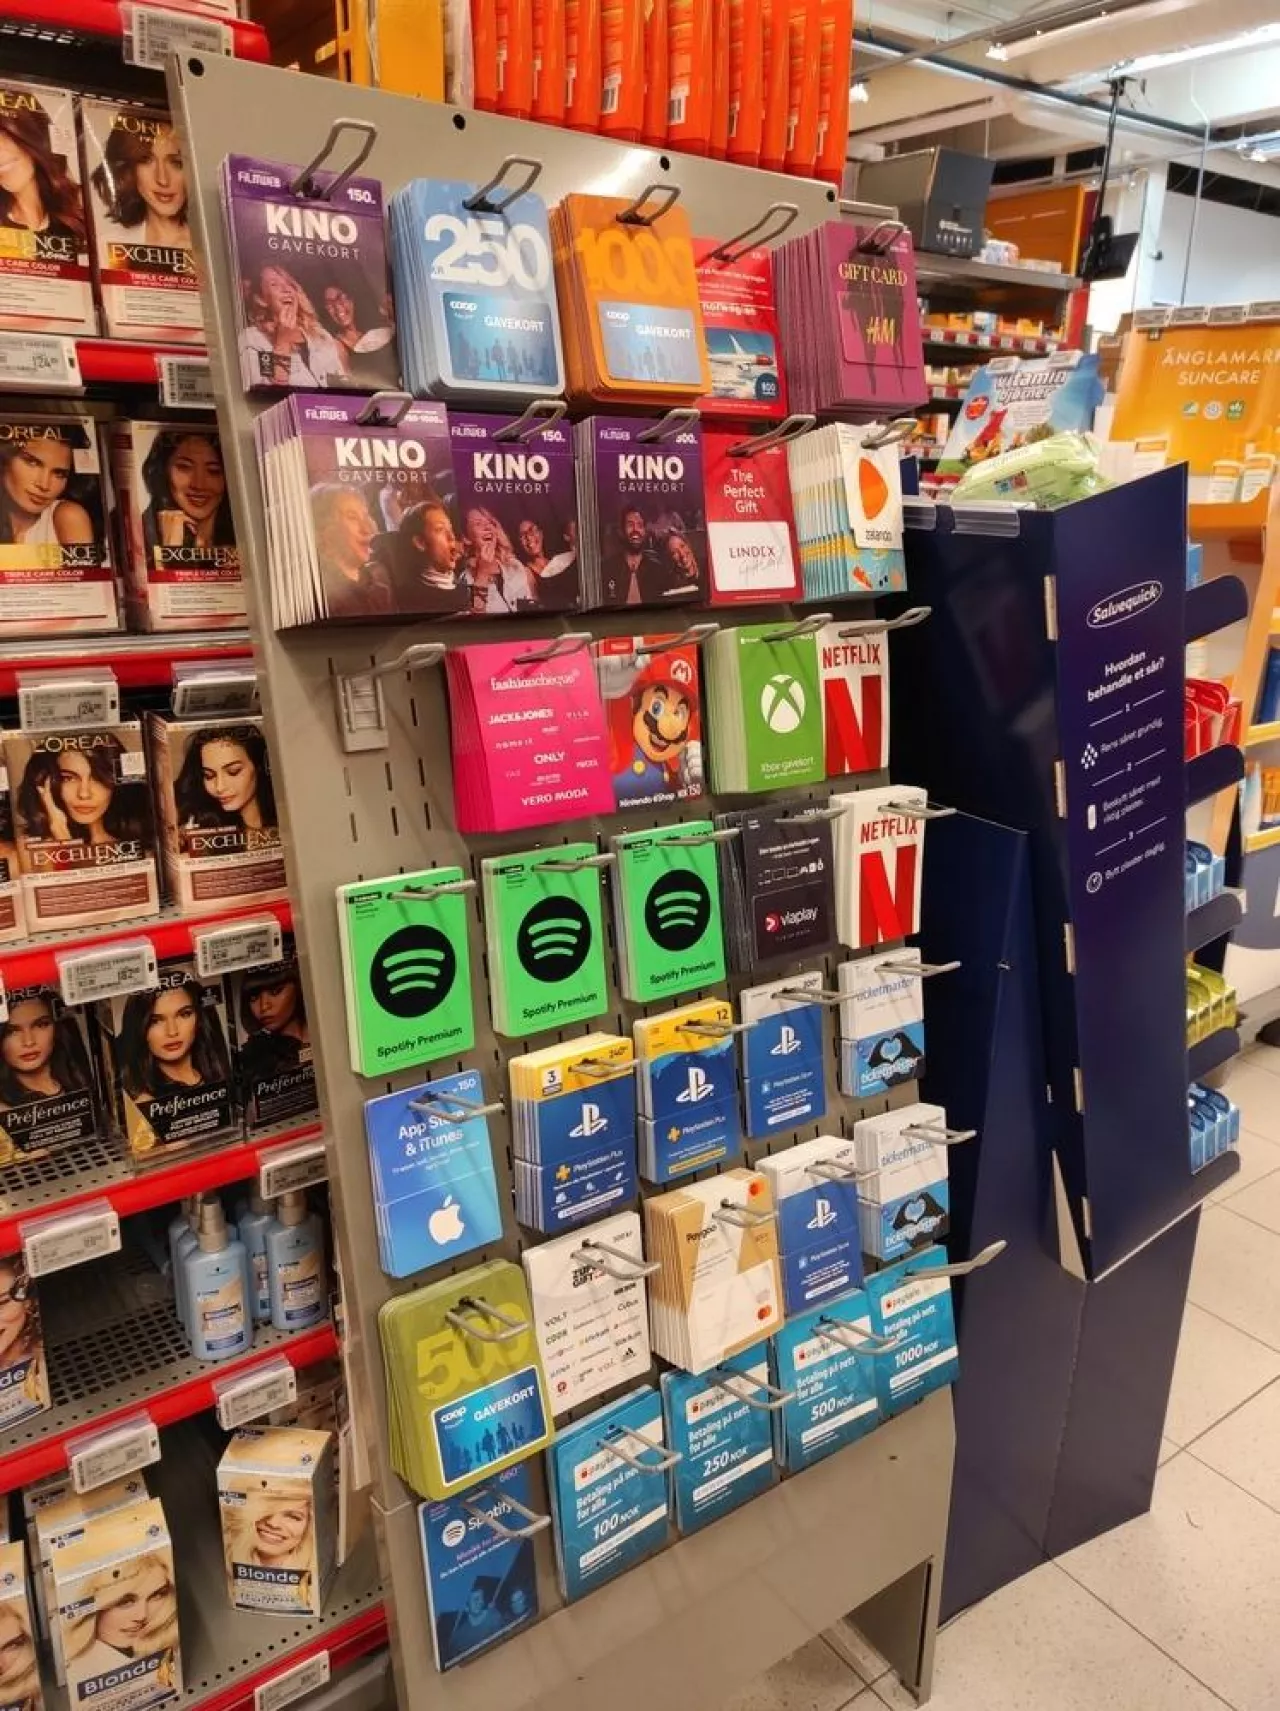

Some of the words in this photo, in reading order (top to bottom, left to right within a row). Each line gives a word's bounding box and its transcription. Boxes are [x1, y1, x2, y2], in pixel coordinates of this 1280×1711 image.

[265, 203, 358, 244] KINO
[267, 238, 361, 260] GAVEKORT
[424, 213, 550, 291] 250
[838, 261, 870, 282] GIFT
[871, 266, 908, 287] CARD
[484, 314, 544, 333] GAVEKORT
[635, 323, 692, 340] GAVEKORT
[865, 316, 896, 346] H&M
[1177, 369, 1261, 386] SUNCARE
[334, 437, 426, 468] KINO
[338, 468, 429, 484] GAVEKORT
[473, 451, 551, 482] KINO
[618, 453, 685, 482] KINO
[730, 468, 755, 485] The
[473, 480, 552, 495] GAVEKORT
[618, 481, 686, 494] GAVEKORT
[722, 483, 767, 500] Perfect
[734, 499, 760, 514] Gift
[728, 546, 777, 560] LINDEX
[1091, 583, 1159, 624] Salvequick
[822, 644, 881, 670] NETFLIX
[1104, 649, 1147, 677] Hvordan
[1086, 674, 1133, 702] behandle
[1133, 670, 1146, 683] et
[533, 751, 566, 765] ONLY
[521, 792, 554, 807] VERO
[554, 786, 589, 802] MODA
[859, 815, 918, 845] NETFLIX
[33, 840, 142, 866] EXCELLENCE
[780, 907, 818, 927] viaplay
[649, 969, 680, 987] Spotify
[680, 958, 717, 978] Premium
[522, 1000, 557, 1021] Spotify
[556, 991, 599, 1013] Premium
[716, 1008, 729, 1021] 12
[377, 1038, 415, 1060] Spotify
[415, 1025, 463, 1051] Premium
[546, 1069, 558, 1084] 3
[149, 1087, 228, 1119] Préférence
[398, 1122, 427, 1140] App
[405, 1142, 417, 1157] &
[418, 1128, 465, 1152] iTunes
[894, 1343, 924, 1369] 1000
[473, 1385, 535, 1421] GAVEKORT
[810, 1396, 836, 1421] 500
[703, 1450, 730, 1477] 250
[593, 1512, 619, 1541] 100
[237, 1564, 301, 1583] Blonde
[83, 1657, 161, 1696] Blonde
